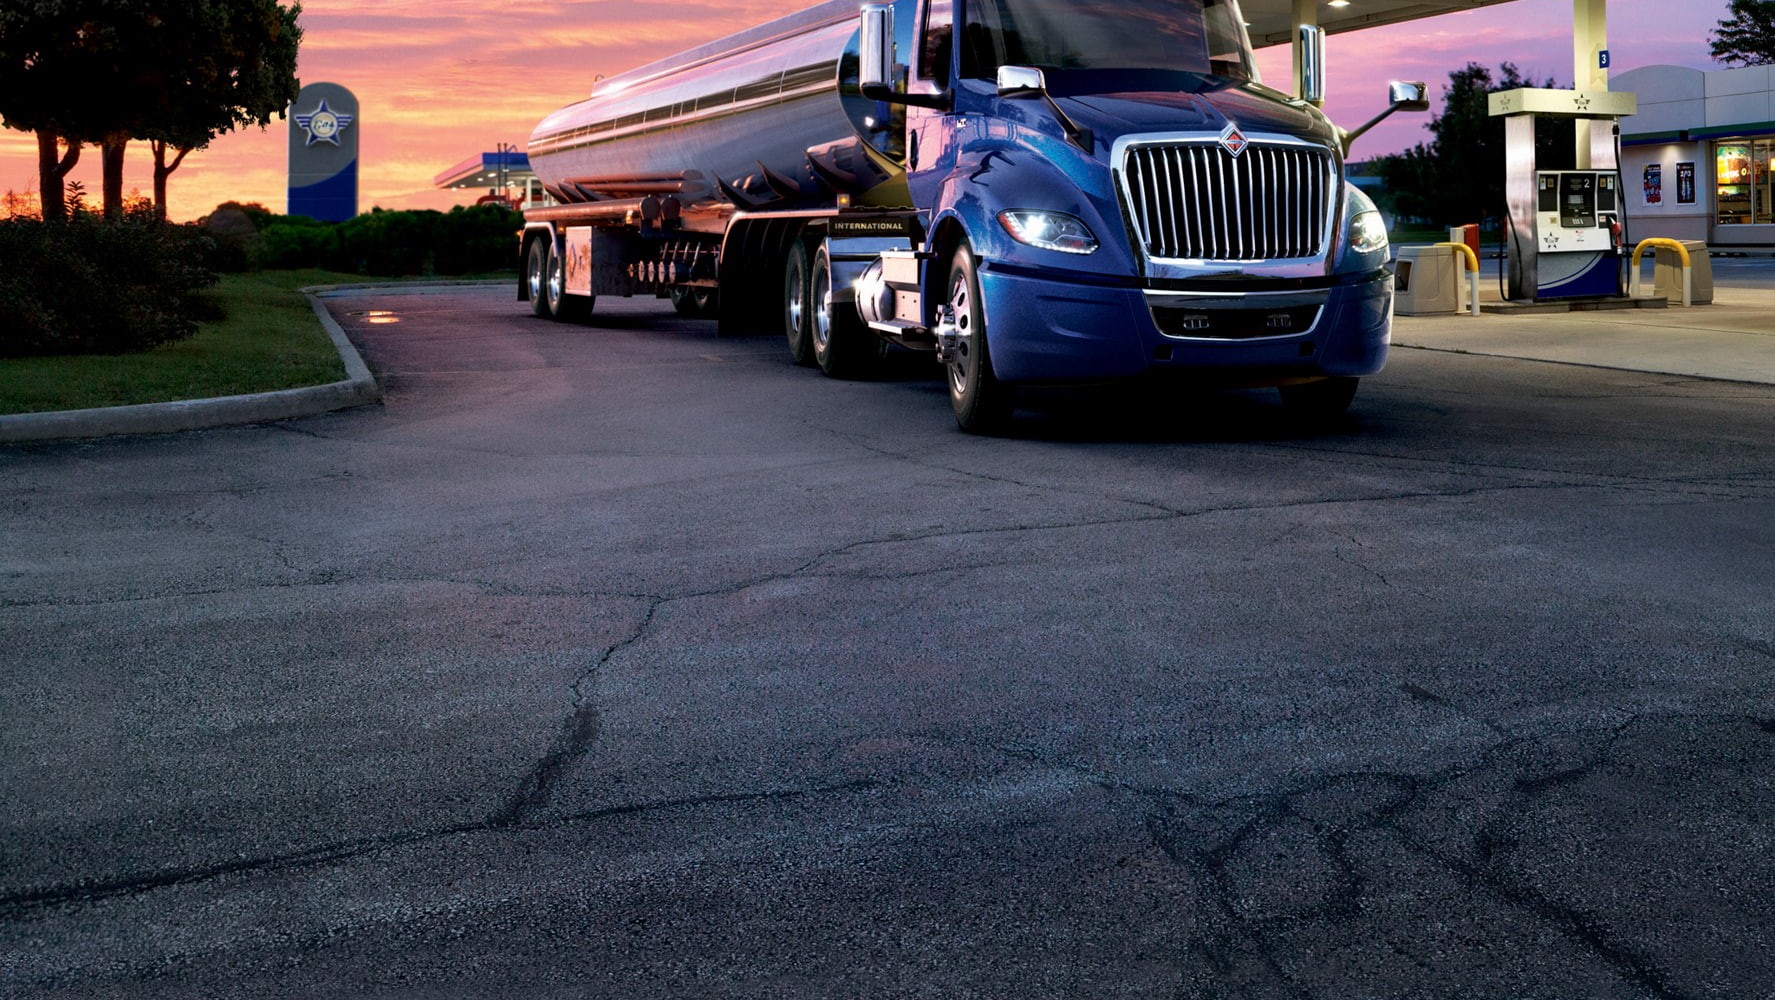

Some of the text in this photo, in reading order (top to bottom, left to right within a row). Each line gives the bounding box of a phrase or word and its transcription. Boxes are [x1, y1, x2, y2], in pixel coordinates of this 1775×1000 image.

[1601, 54, 1607, 65] 3
[1584, 178, 1590, 189] 2
[834, 222, 903, 230] INTERNATIONAL
